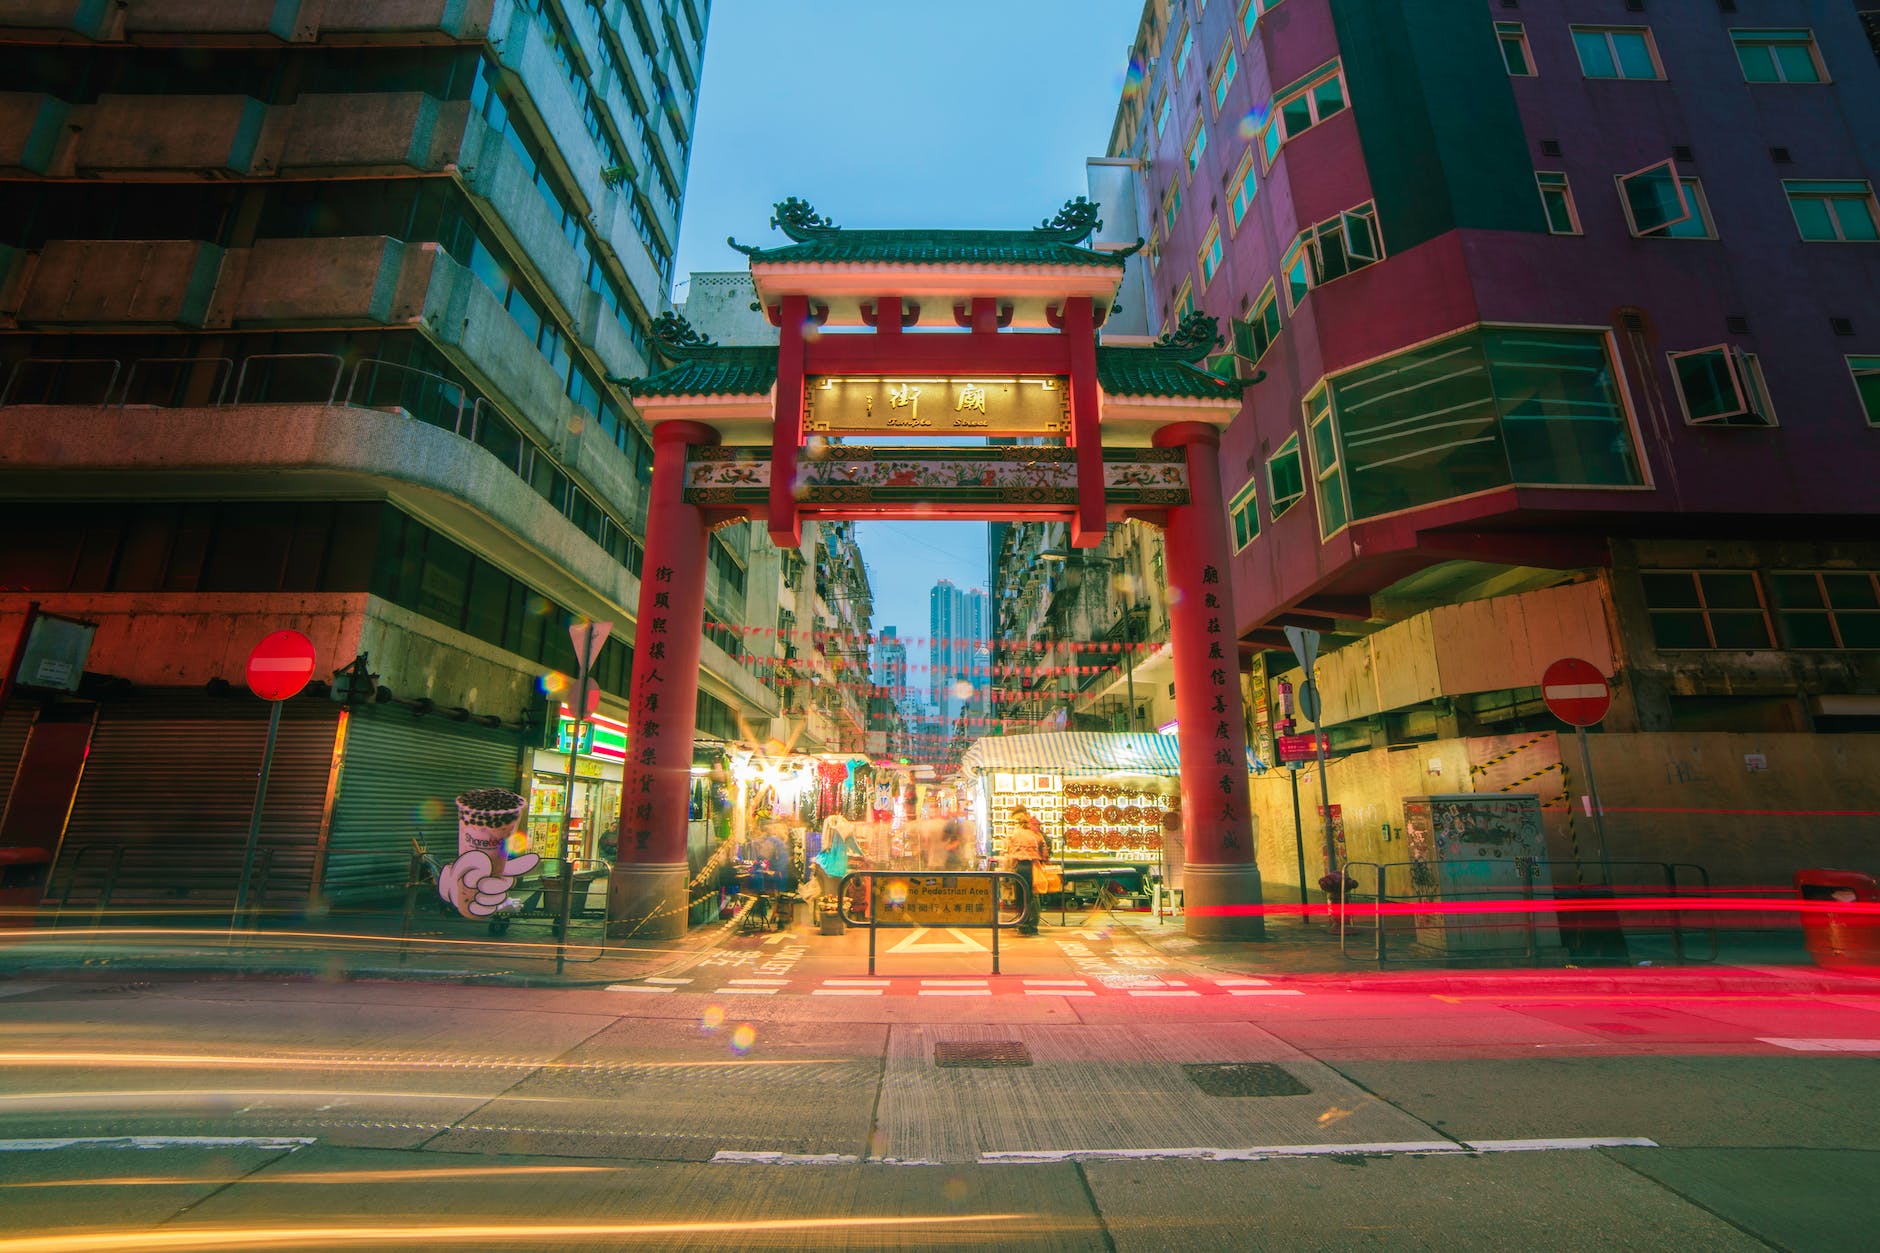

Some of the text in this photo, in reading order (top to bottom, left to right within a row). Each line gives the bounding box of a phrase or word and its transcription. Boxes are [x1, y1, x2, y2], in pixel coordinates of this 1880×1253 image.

[887, 418, 989, 427] Temple Street
[922, 887, 967, 896] Pedestrian
[969, 887, 990, 896] Area
